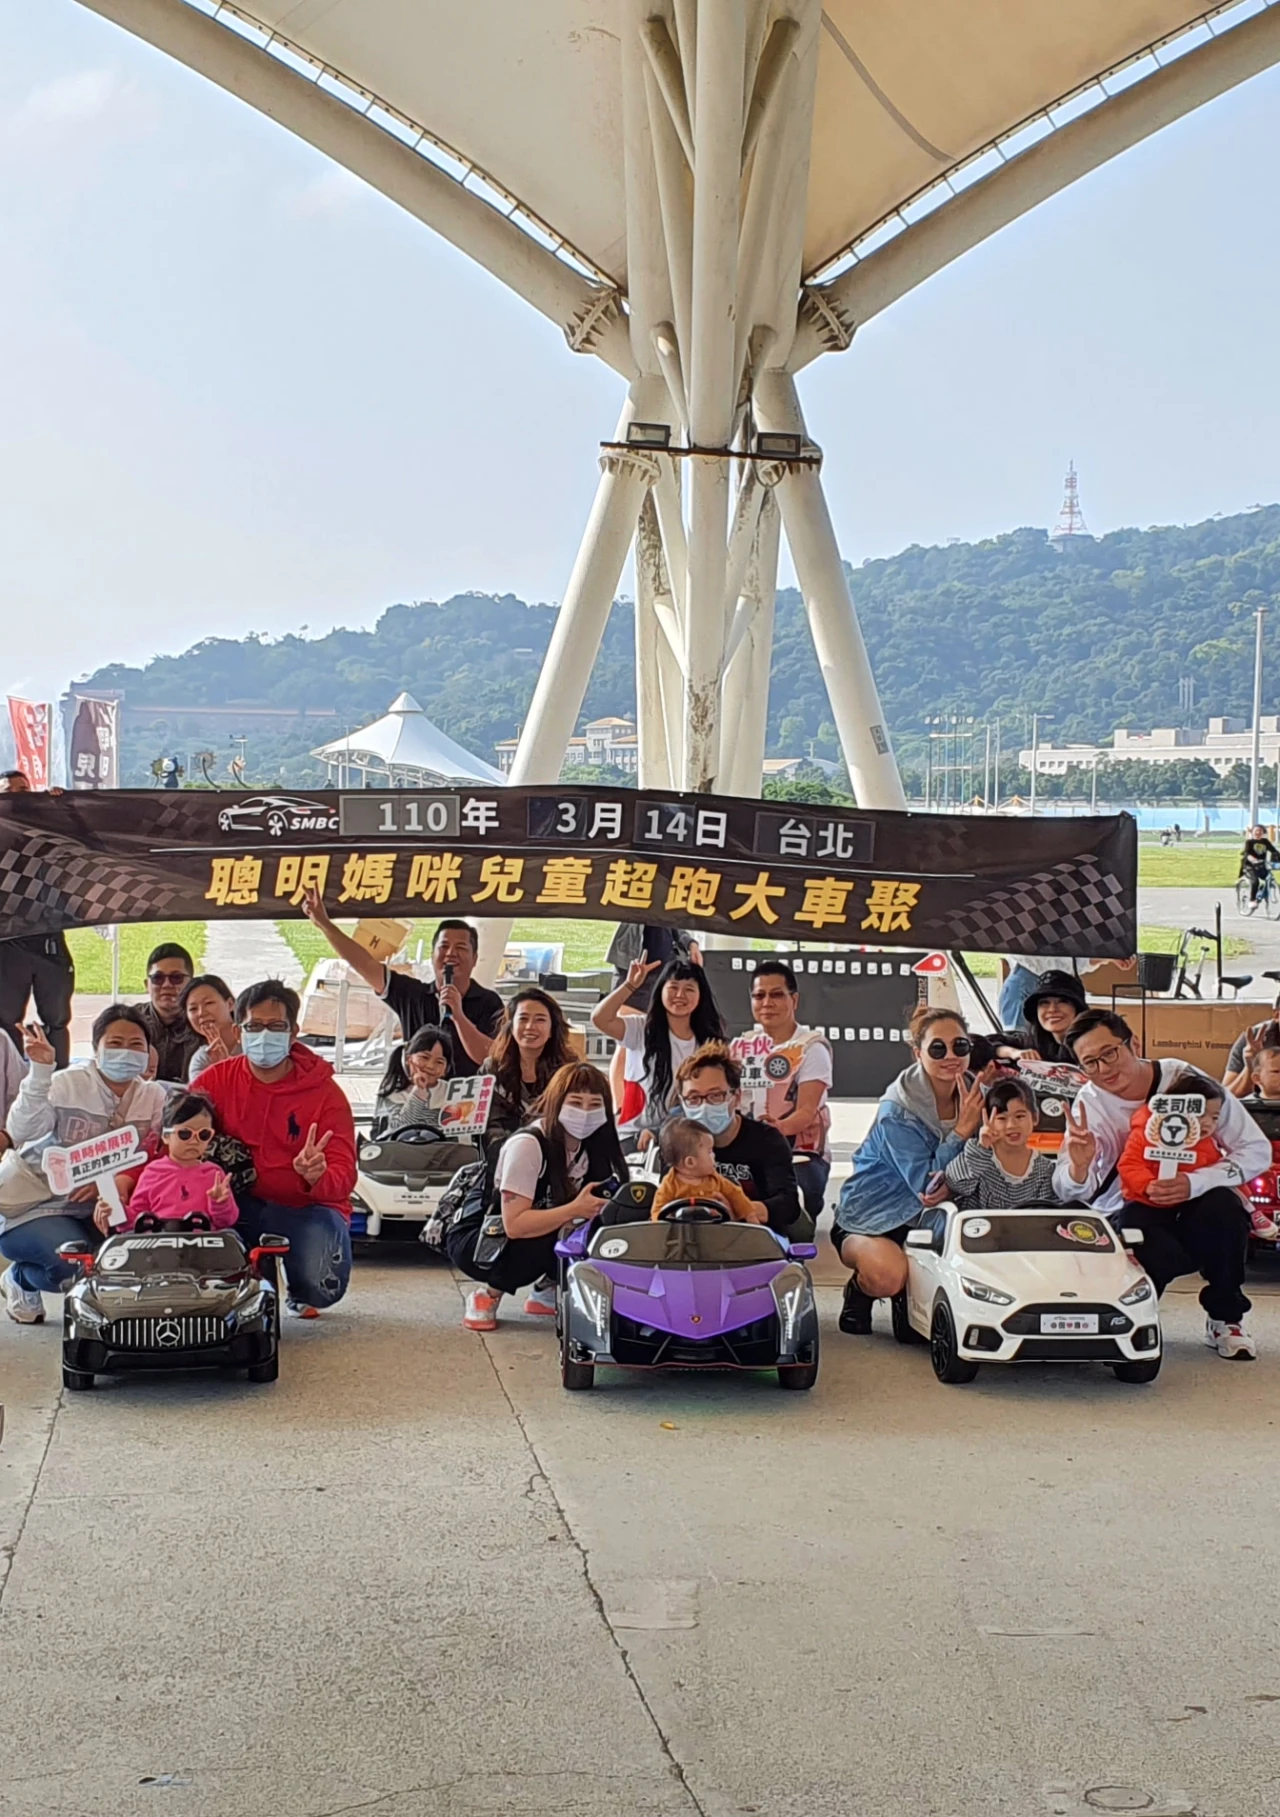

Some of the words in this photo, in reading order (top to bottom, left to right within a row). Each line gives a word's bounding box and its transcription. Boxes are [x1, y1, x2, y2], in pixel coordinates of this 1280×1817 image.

[290, 817, 340, 831] SMBC
[778, 818, 854, 859] 台北
[205, 852, 922, 934] 聰明媽咪兒童超跑大車聚
[1152, 1039, 1202, 1050] Lamborghini
[447, 1079, 475, 1101] F1
[1152, 1097, 1203, 1114] 老司機
[154, 1237, 225, 1249] AMG
